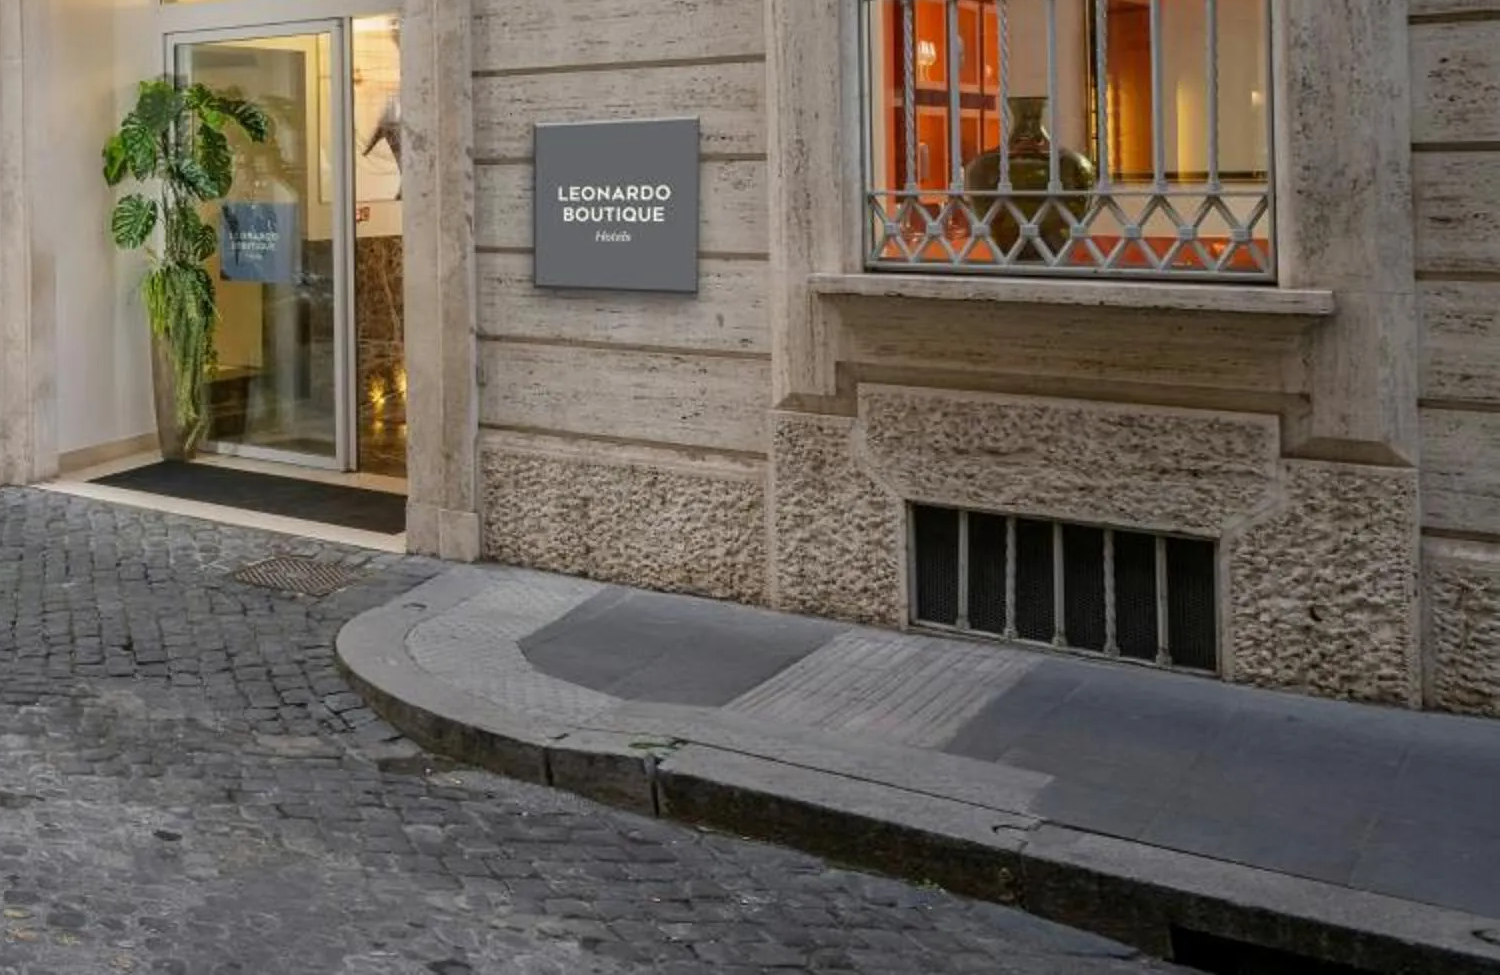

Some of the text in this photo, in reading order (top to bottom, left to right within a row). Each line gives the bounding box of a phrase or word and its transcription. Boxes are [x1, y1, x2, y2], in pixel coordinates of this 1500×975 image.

[557, 184, 671, 202] LEONARDO
[563, 206, 665, 222] BOUTIQUE
[595, 229, 632, 242] Hotels
